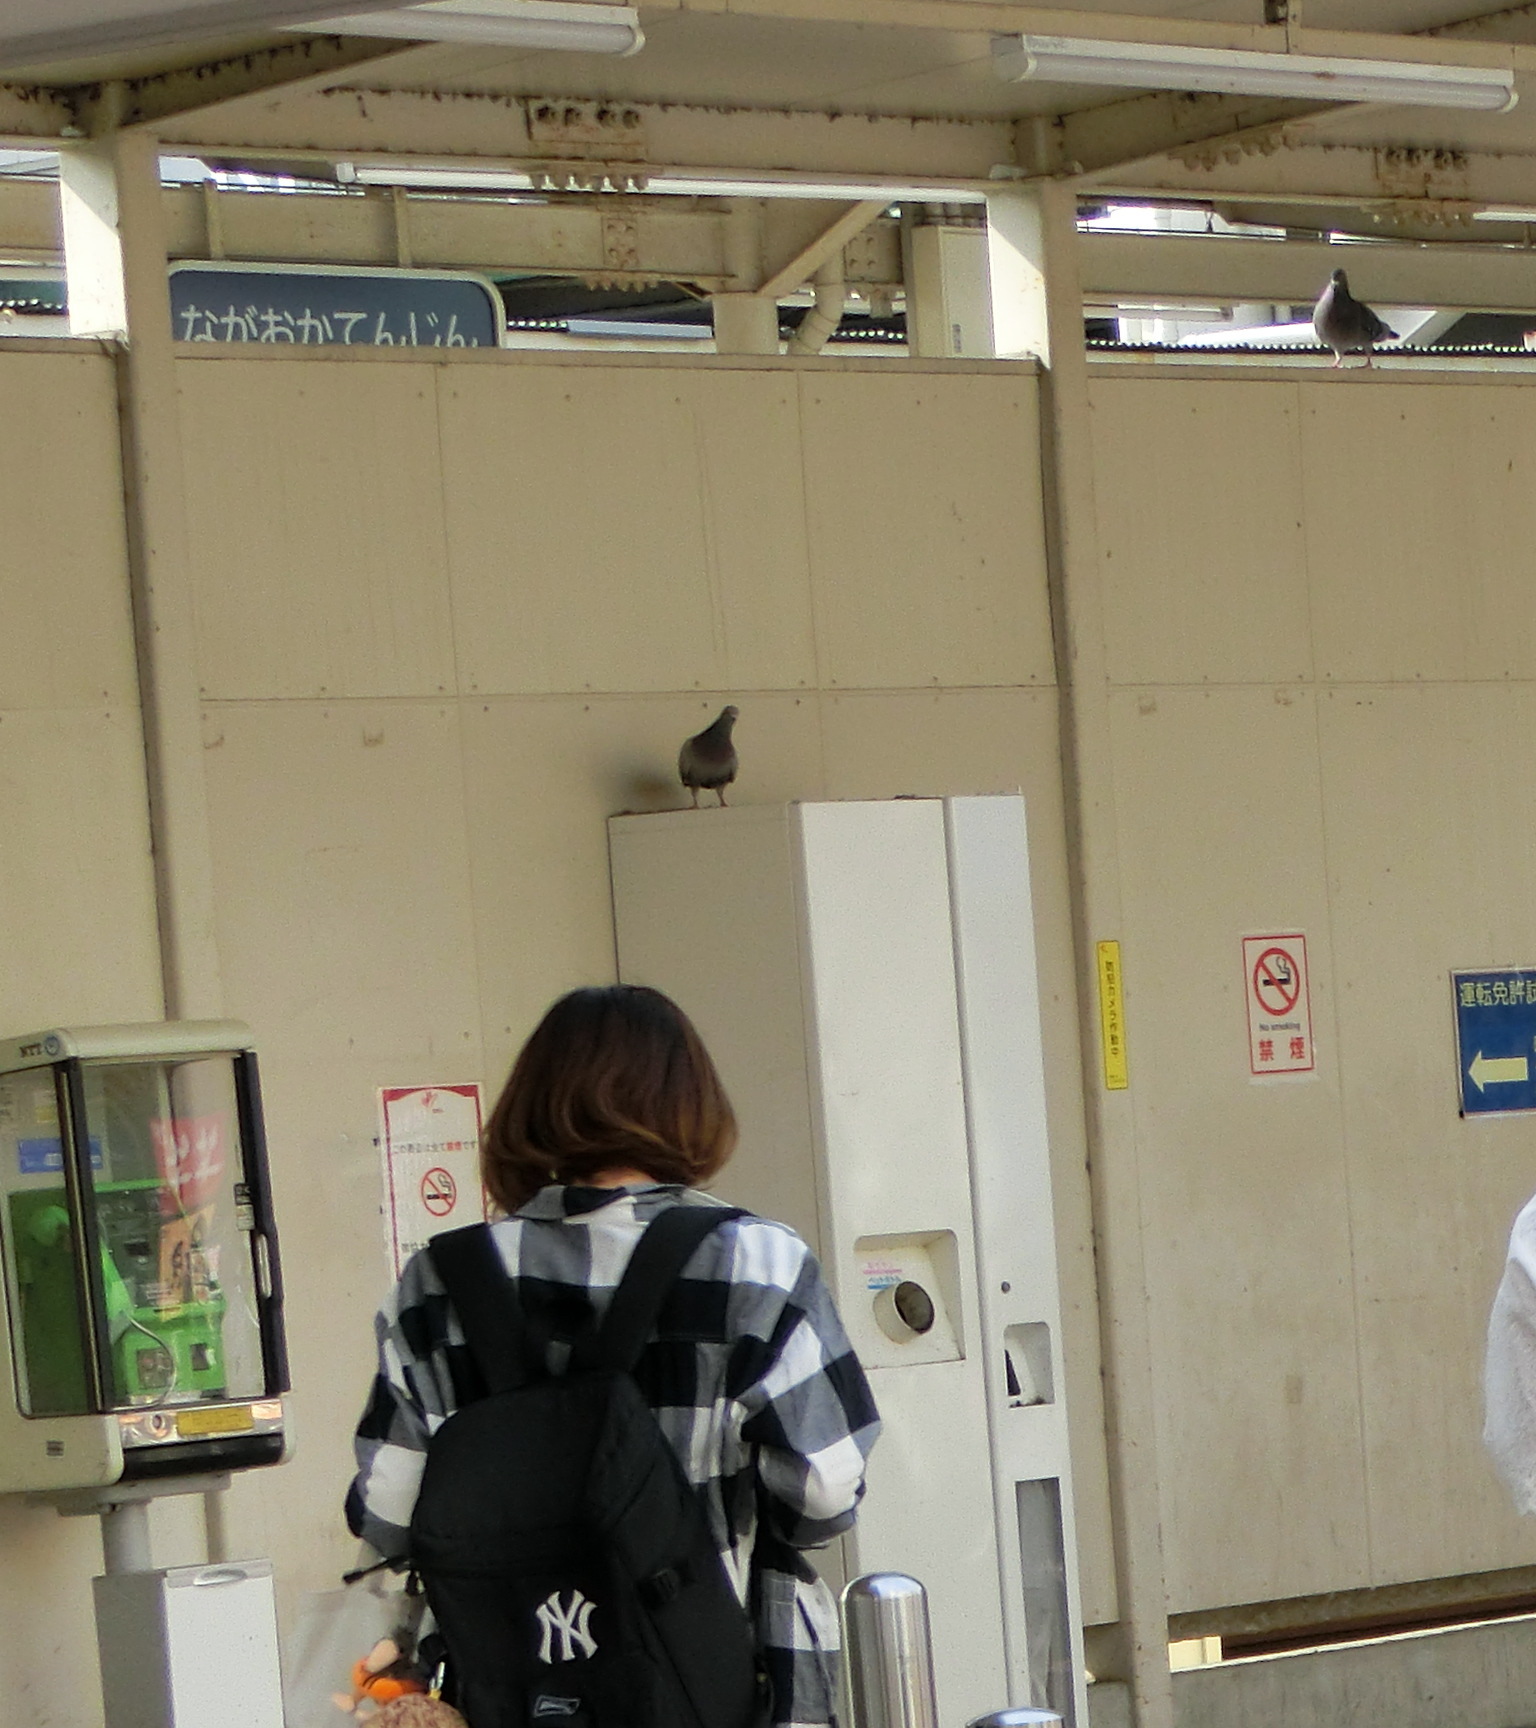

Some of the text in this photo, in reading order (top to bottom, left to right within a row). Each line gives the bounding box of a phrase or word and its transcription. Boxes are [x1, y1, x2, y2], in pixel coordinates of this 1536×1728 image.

[181, 304, 479, 347] ながおかてんじん
[536, 1589, 598, 1664] NY
